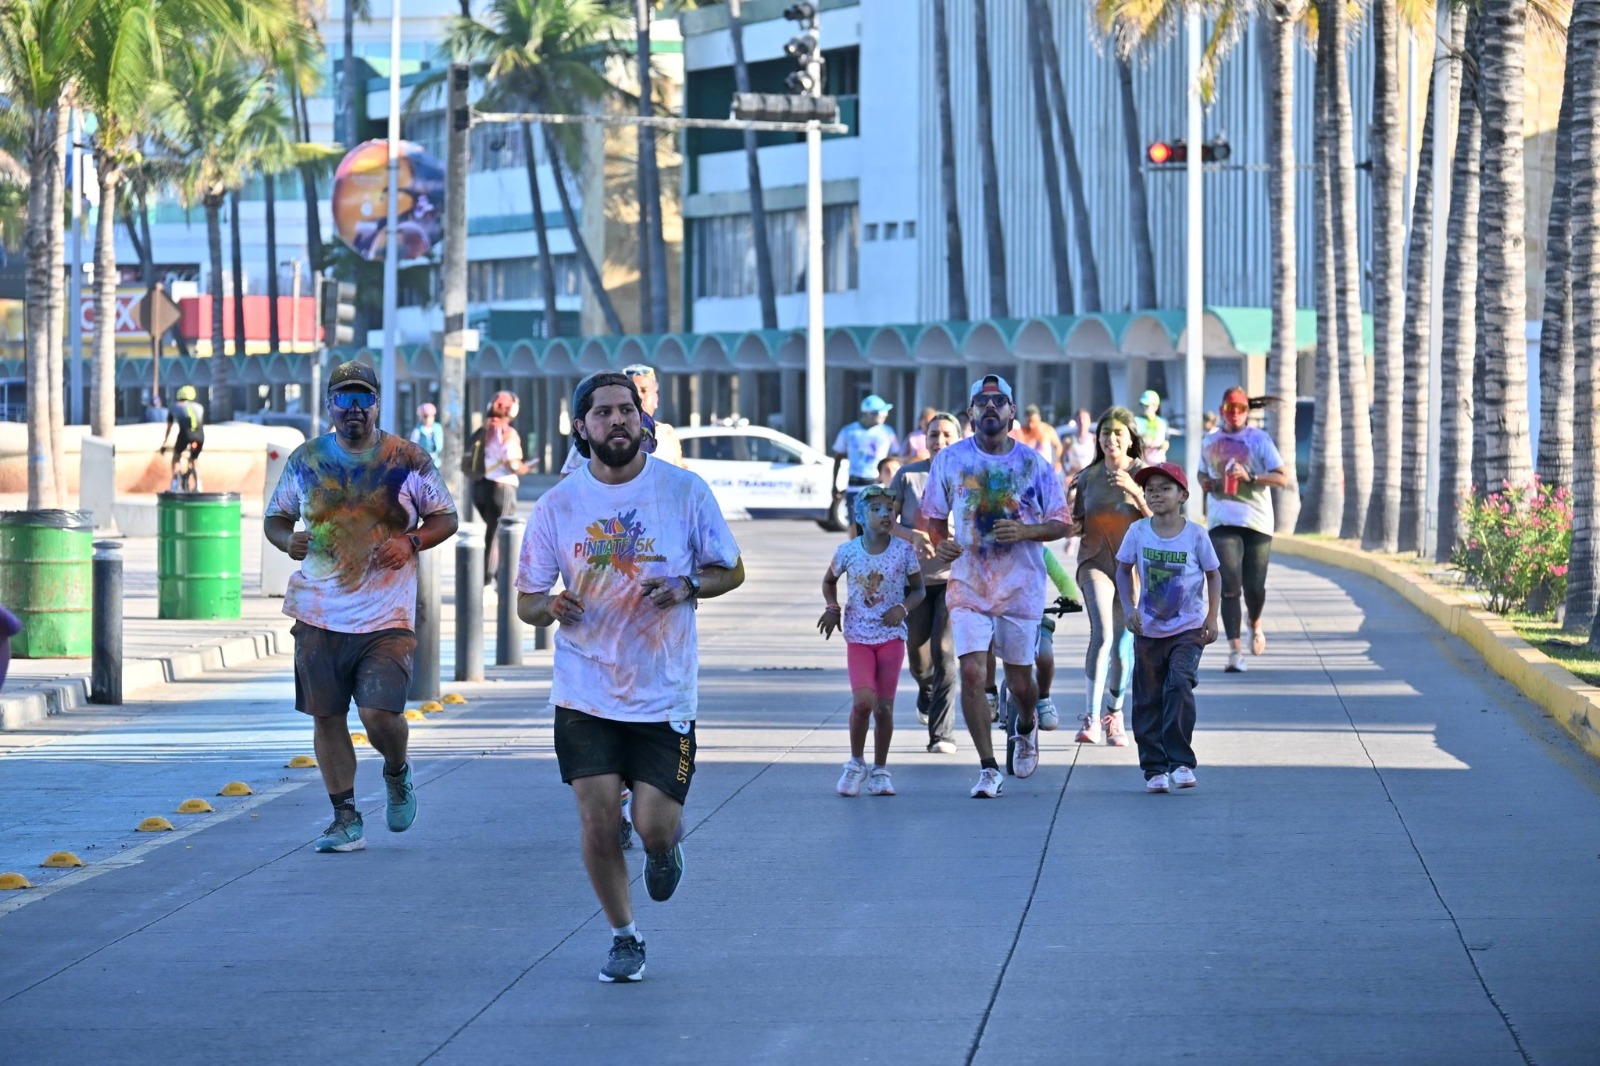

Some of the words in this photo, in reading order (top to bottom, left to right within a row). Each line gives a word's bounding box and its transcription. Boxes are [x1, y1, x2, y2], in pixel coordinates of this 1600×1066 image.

[574, 536, 630, 558] PÍNTATE
[635, 537, 656, 553] 5K
[676, 737, 690, 784] STEEERS
